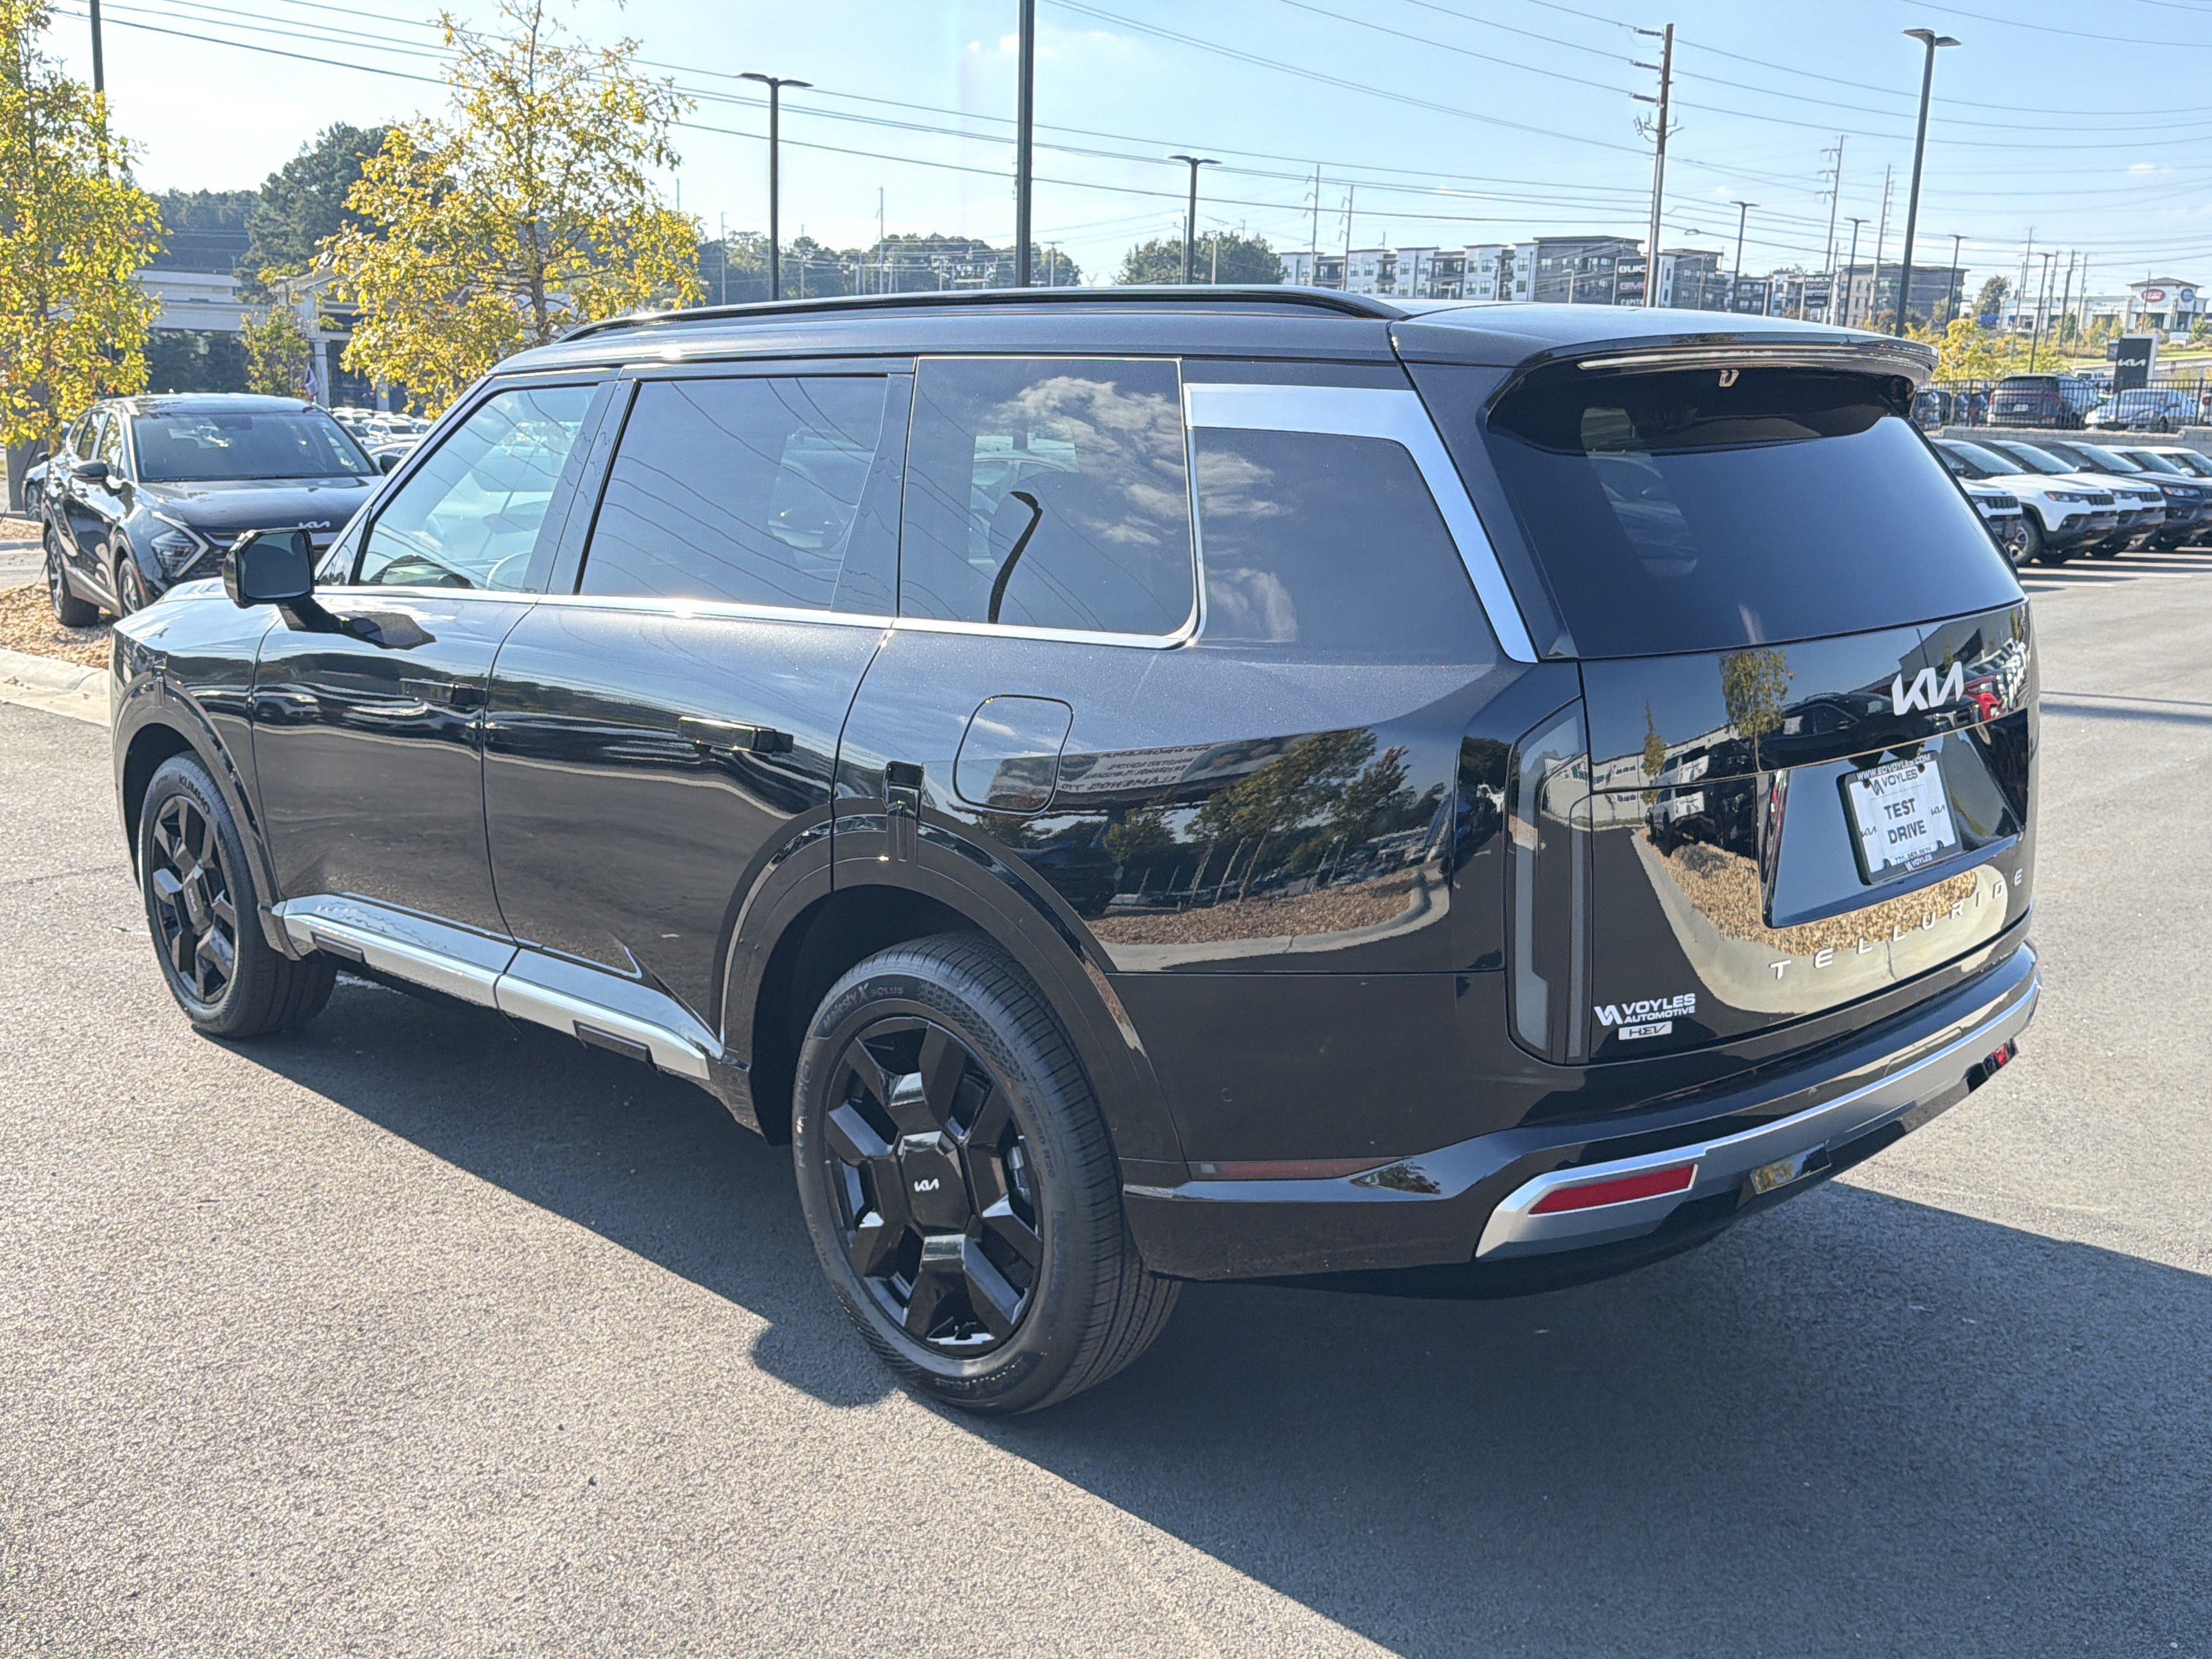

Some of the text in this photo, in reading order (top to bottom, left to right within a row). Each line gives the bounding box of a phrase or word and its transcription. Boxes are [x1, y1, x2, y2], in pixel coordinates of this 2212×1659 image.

[1618, 265, 1647, 273] BUIC
[2118, 358, 2146, 366] KIA
[1892, 661, 1964, 716] KIA
[1881, 769, 1918, 787] VOYLES
[1884, 798, 1916, 820] TEST
[1887, 820, 1927, 844] DRIVE
[1769, 868, 2023, 980] TELLURIDE
[1622, 993, 1696, 1015] VOYLES
[1624, 1006, 1696, 1024] AUTOMOTIVE
[1629, 1024, 1667, 1037] HEV
[913, 1178, 940, 1192] KIA
